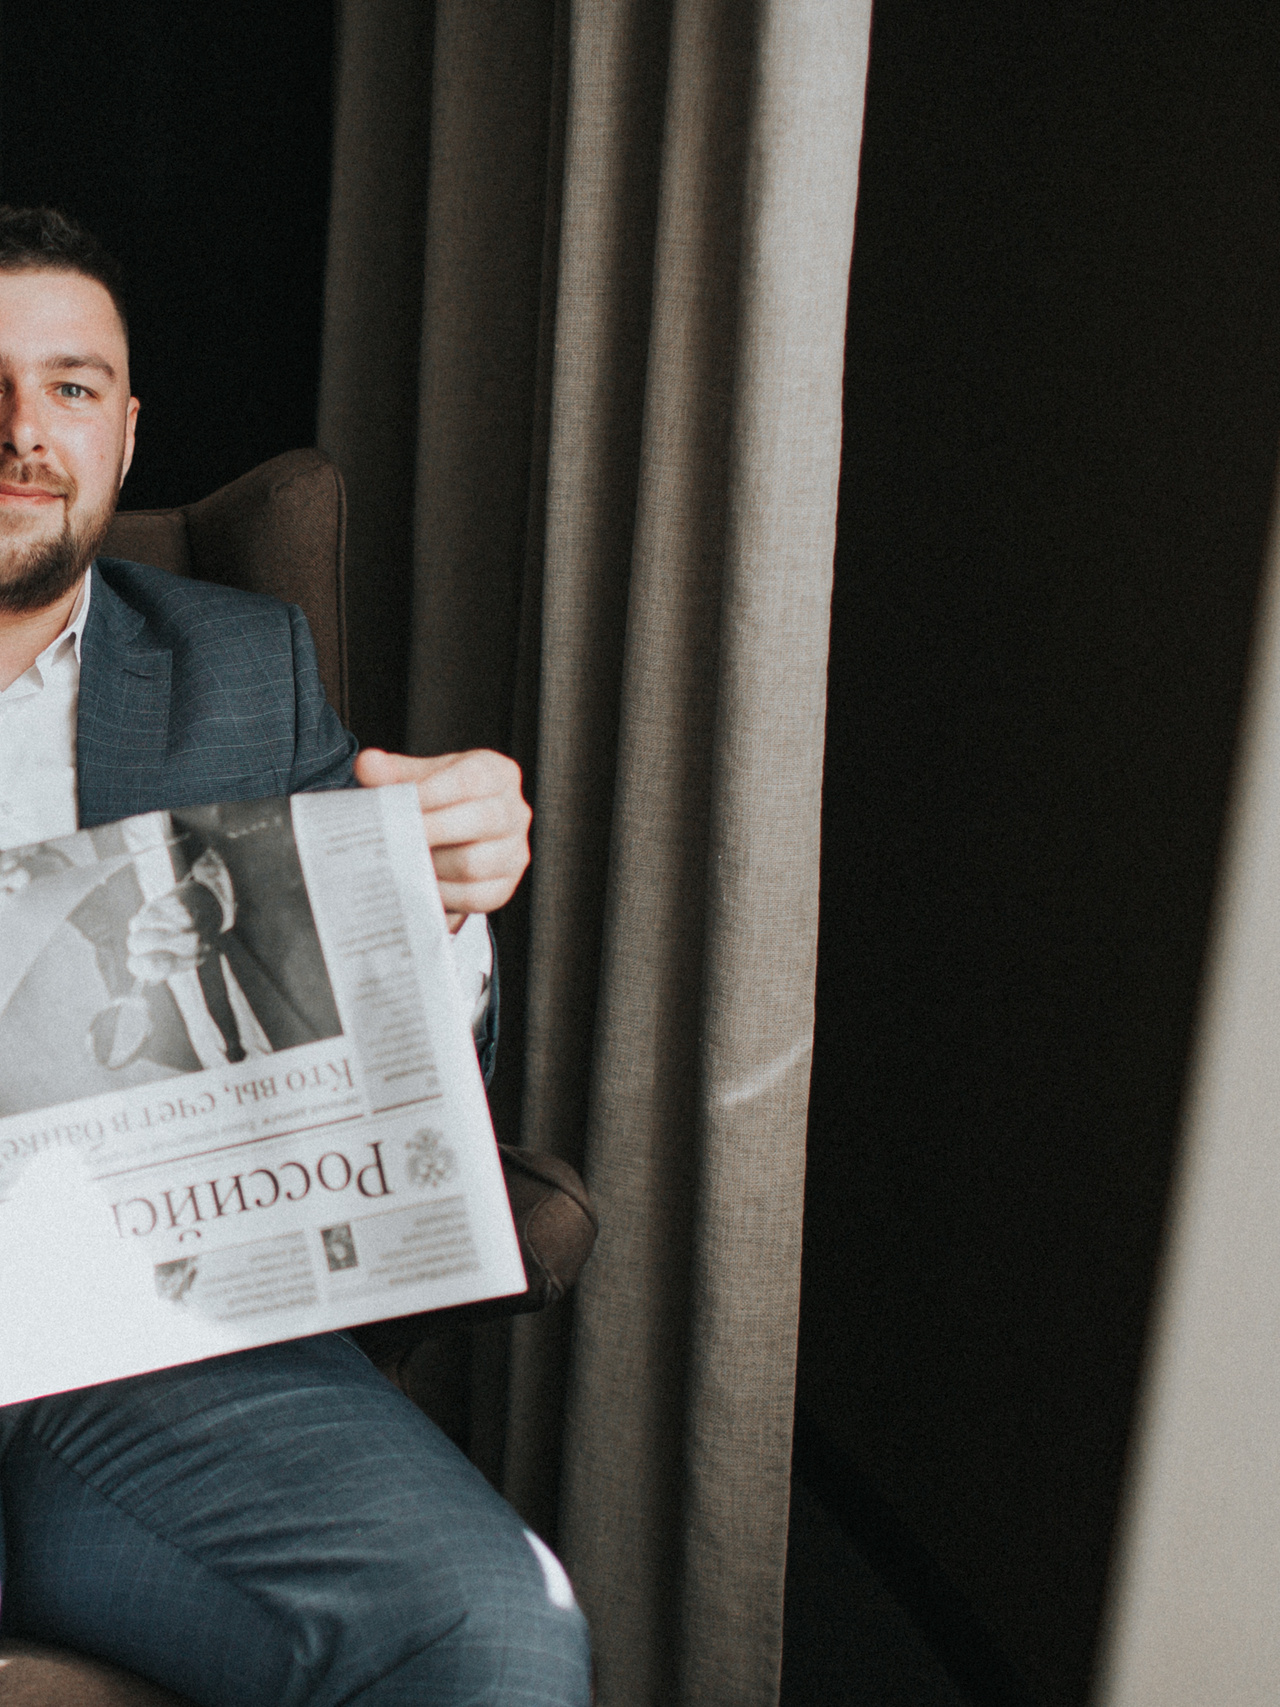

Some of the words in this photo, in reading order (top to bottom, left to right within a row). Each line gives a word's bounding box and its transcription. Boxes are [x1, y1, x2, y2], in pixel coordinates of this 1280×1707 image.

[223, 1076, 279, 1105] вы,
[285, 1057, 354, 1092] Кто
[111, 1111, 131, 1134] в
[142, 1091, 216, 1127] счет
[111, 1140, 395, 1242] Российс
